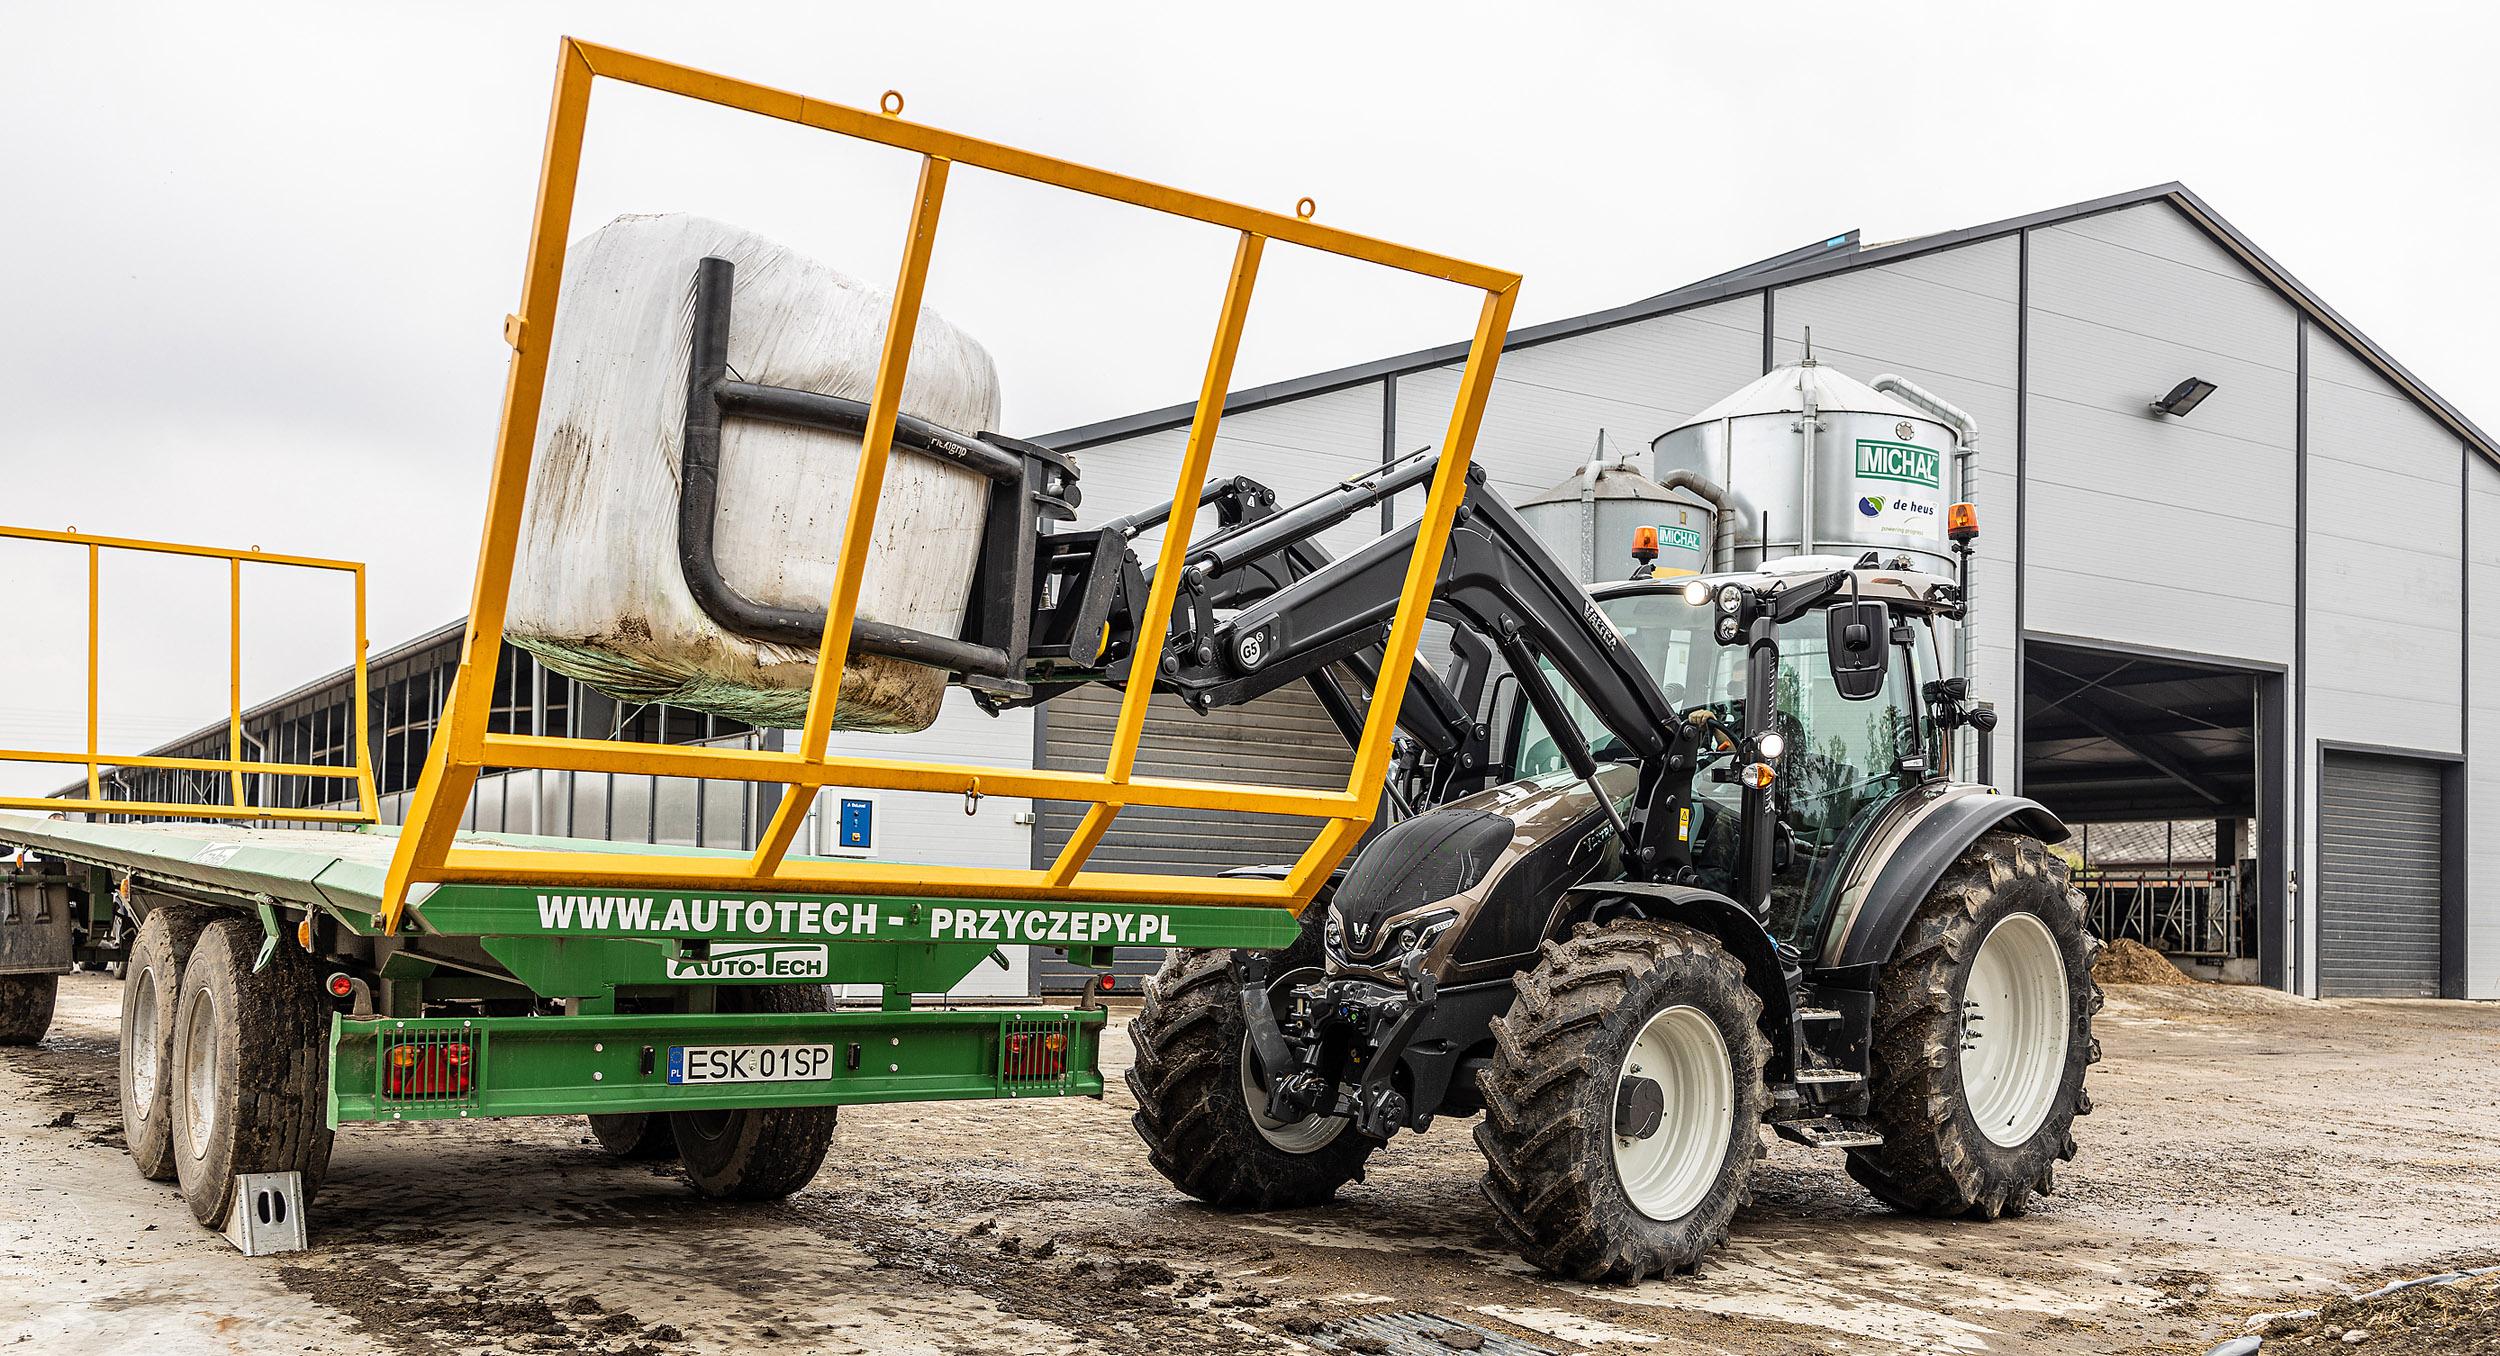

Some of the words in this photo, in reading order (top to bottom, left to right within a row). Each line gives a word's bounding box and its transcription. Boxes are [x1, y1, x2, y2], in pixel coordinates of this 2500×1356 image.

[1864, 446, 1937, 481] MICHAŁ
[1893, 500, 1908, 510] de
[1910, 501, 1934, 515] heus
[1243, 642, 1257, 659] G5
[537, 895, 877, 935] WWW.AUTOTECH
[930, 908, 1176, 943] PRZYCZEPY.PL
[670, 1069, 682, 1078] PL
[688, 1049, 750, 1080] ESK
[760, 1048, 829, 1077] 01SP
